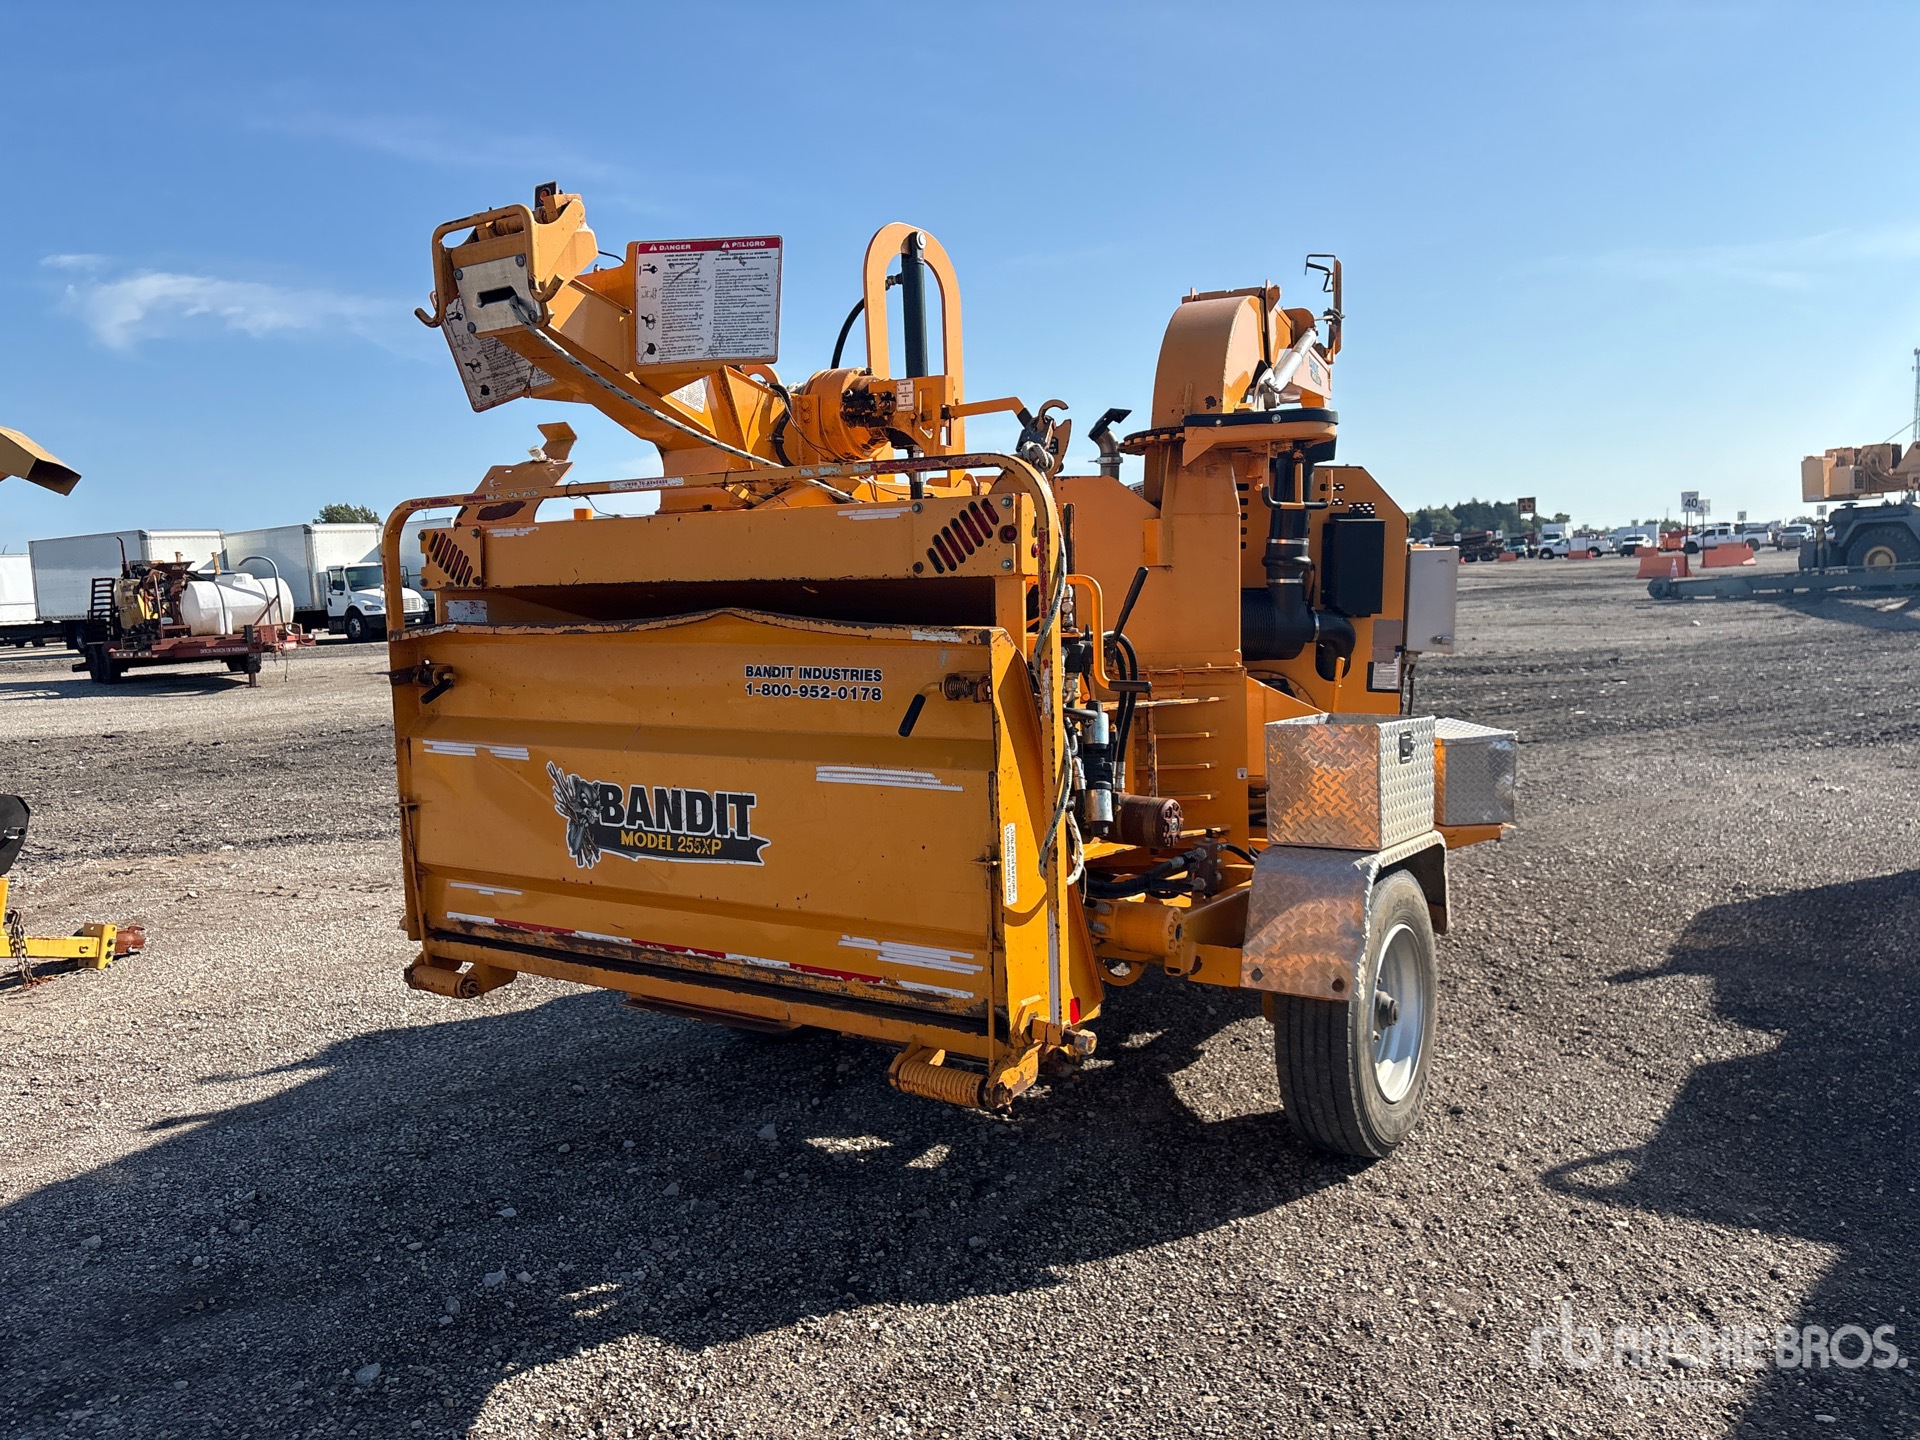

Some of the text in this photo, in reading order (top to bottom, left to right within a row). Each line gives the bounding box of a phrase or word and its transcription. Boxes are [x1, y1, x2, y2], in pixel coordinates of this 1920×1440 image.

[731, 240, 767, 248] PELIGRO
[1684, 498, 1698, 508] 40
[745, 665, 882, 682] BANDIT INDUSTRIES
[745, 682, 882, 701] 1-800-952-0178
[600, 784, 755, 838] BANDIT
[620, 830, 722, 855] MODEL 255XP
